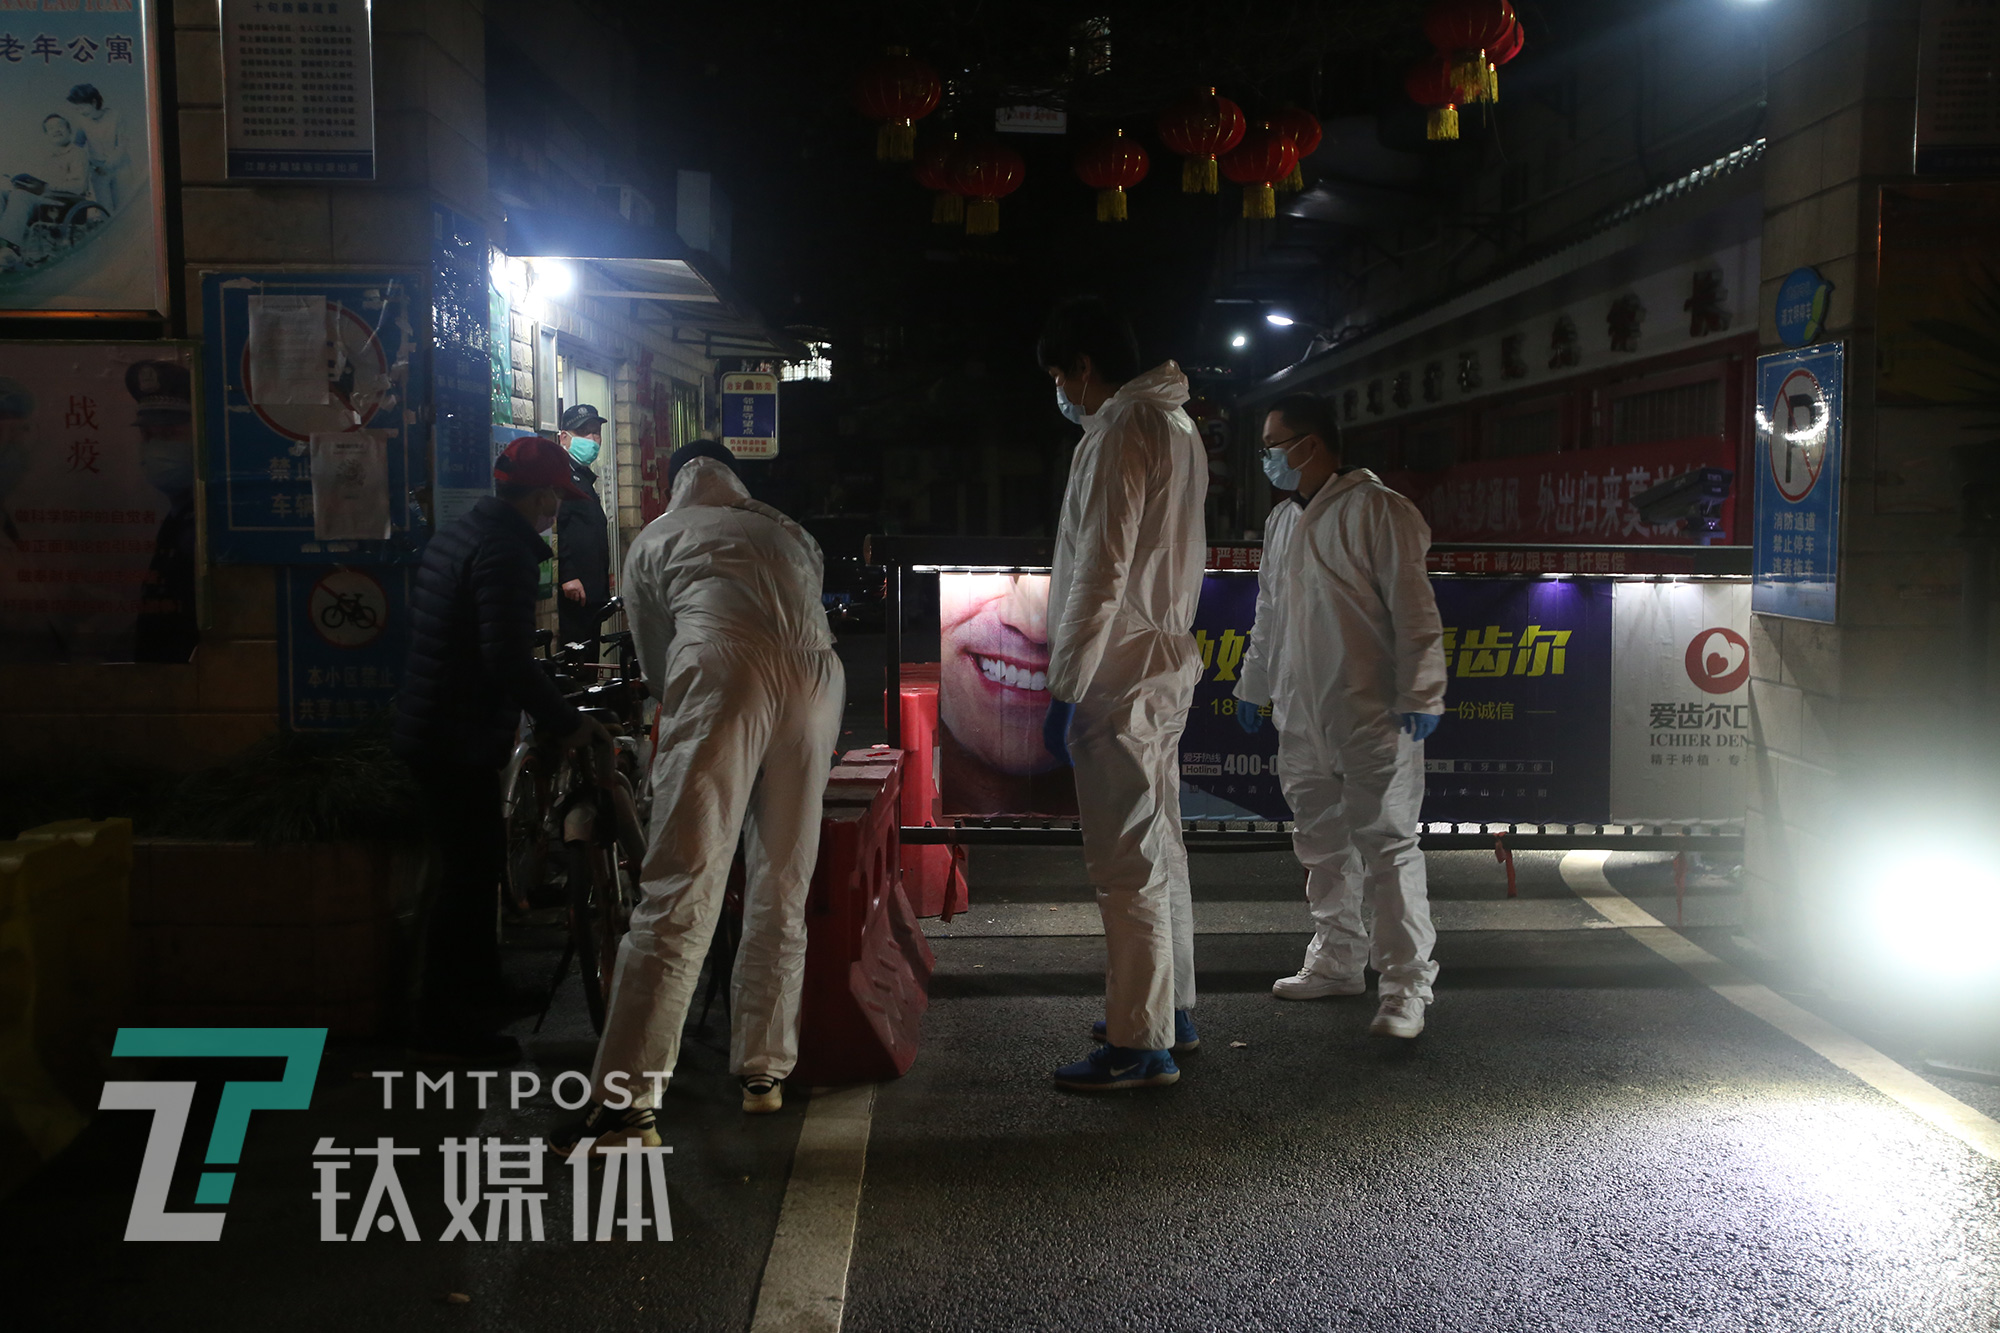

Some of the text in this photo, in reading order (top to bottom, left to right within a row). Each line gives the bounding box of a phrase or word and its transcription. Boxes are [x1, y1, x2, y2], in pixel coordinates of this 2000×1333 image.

[0, 33, 133, 64] 老年公寓
[65, 395, 100, 474] 战疫
[269, 456, 311, 482] 禁止
[271, 492, 314, 518] 车辆
[1773, 511, 1816, 531] 消防通道
[1772, 534, 1815, 555] 禁止停车
[1425, 552, 1626, 571] 一车一杆 请勿跟车 撞杆赔偿
[1772, 557, 1814, 578] 违者拖车
[307, 665, 395, 688] 本小区禁止
[1444, 701, 1515, 721] 一份诚信
[1649, 733, 1711, 747] ICHIER
[1183, 752, 1222, 763] 爱牙热线
[1186, 765, 1218, 774] Hotline
